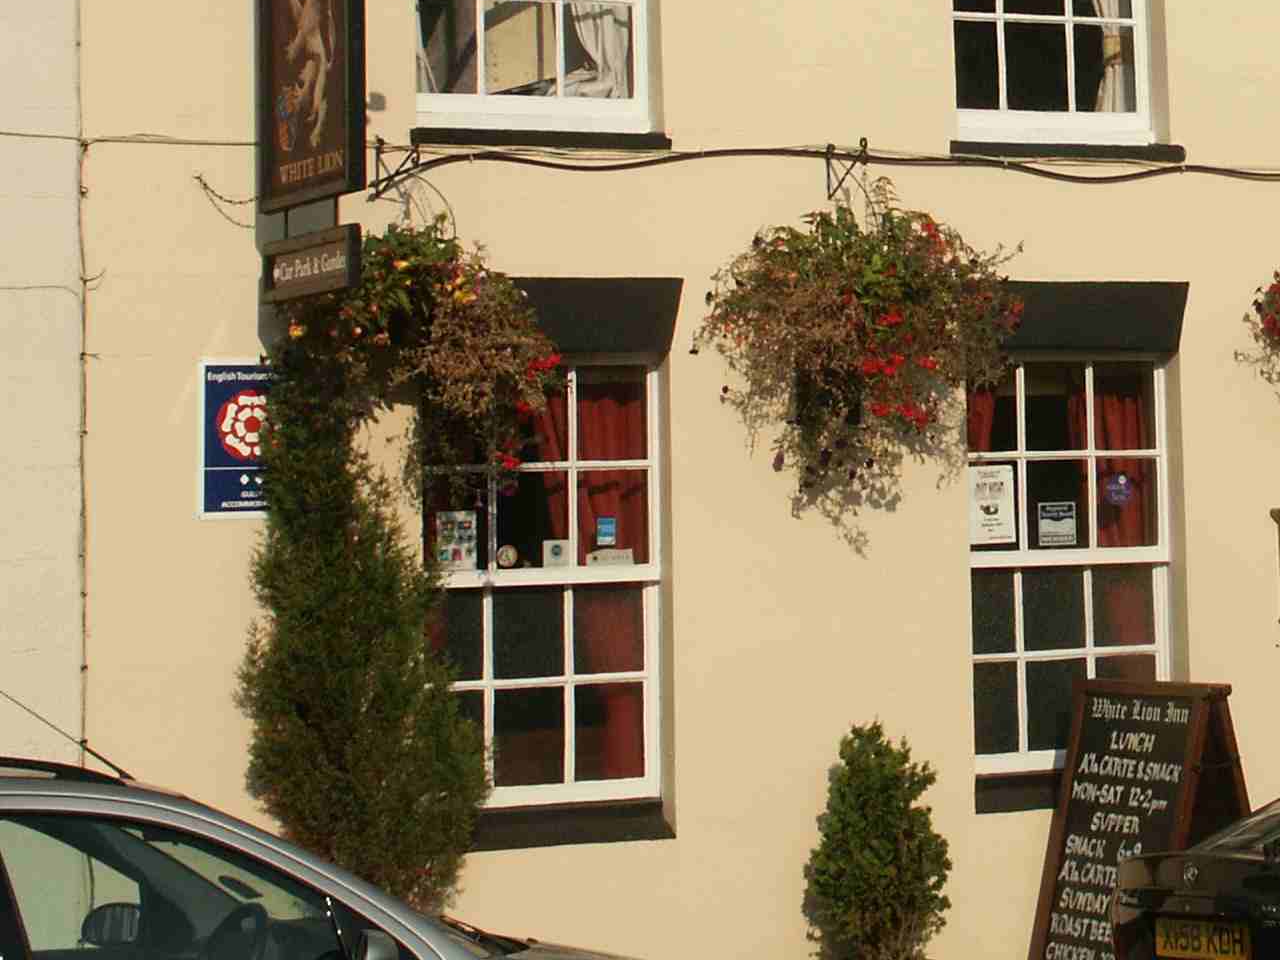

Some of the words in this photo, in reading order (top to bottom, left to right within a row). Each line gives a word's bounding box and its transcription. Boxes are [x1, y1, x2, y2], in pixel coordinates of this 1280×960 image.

[279, 157, 316, 184] WHITE
[318, 148, 344, 175] LION
[1091, 697, 1127, 721] White
[1132, 699, 1161, 721] Lion
[1163, 701, 1190, 724] Inn
[1110, 730, 1156, 753] LUNCH
[1099, 755, 1137, 778] CARTE
[1090, 811, 1140, 835] SUPPER
[1065, 833, 1107, 859] SNACK
[1080, 862, 1118, 889] CARTE
[1060, 887, 1111, 915] SUNDAY
[1050, 911, 1089, 938] ROAST
[1089, 919, 1115, 943] BEE
